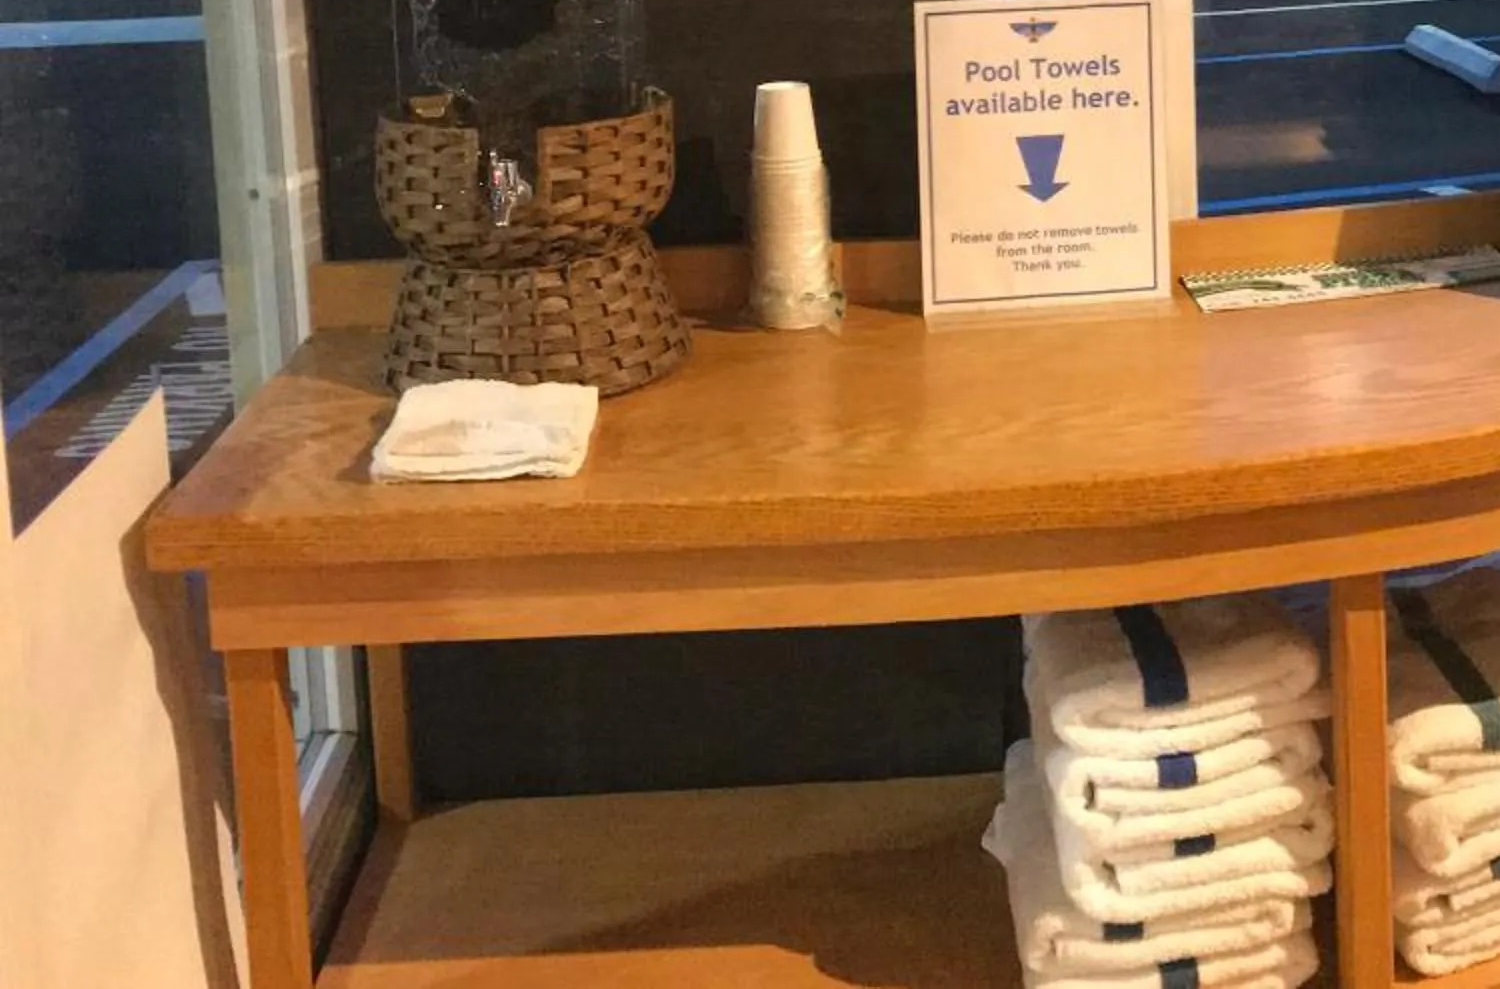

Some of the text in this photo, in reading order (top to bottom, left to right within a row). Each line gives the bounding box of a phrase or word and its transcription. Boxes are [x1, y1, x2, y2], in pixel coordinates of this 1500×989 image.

[965, 55, 1121, 83] Pool Towels
[945, 86, 1140, 116] available here.
[950, 222, 1139, 244] Please do not remove towels
[996, 244, 1028, 258] from
[1031, 242, 1053, 256] the
[1013, 258, 1052, 272] Thank
